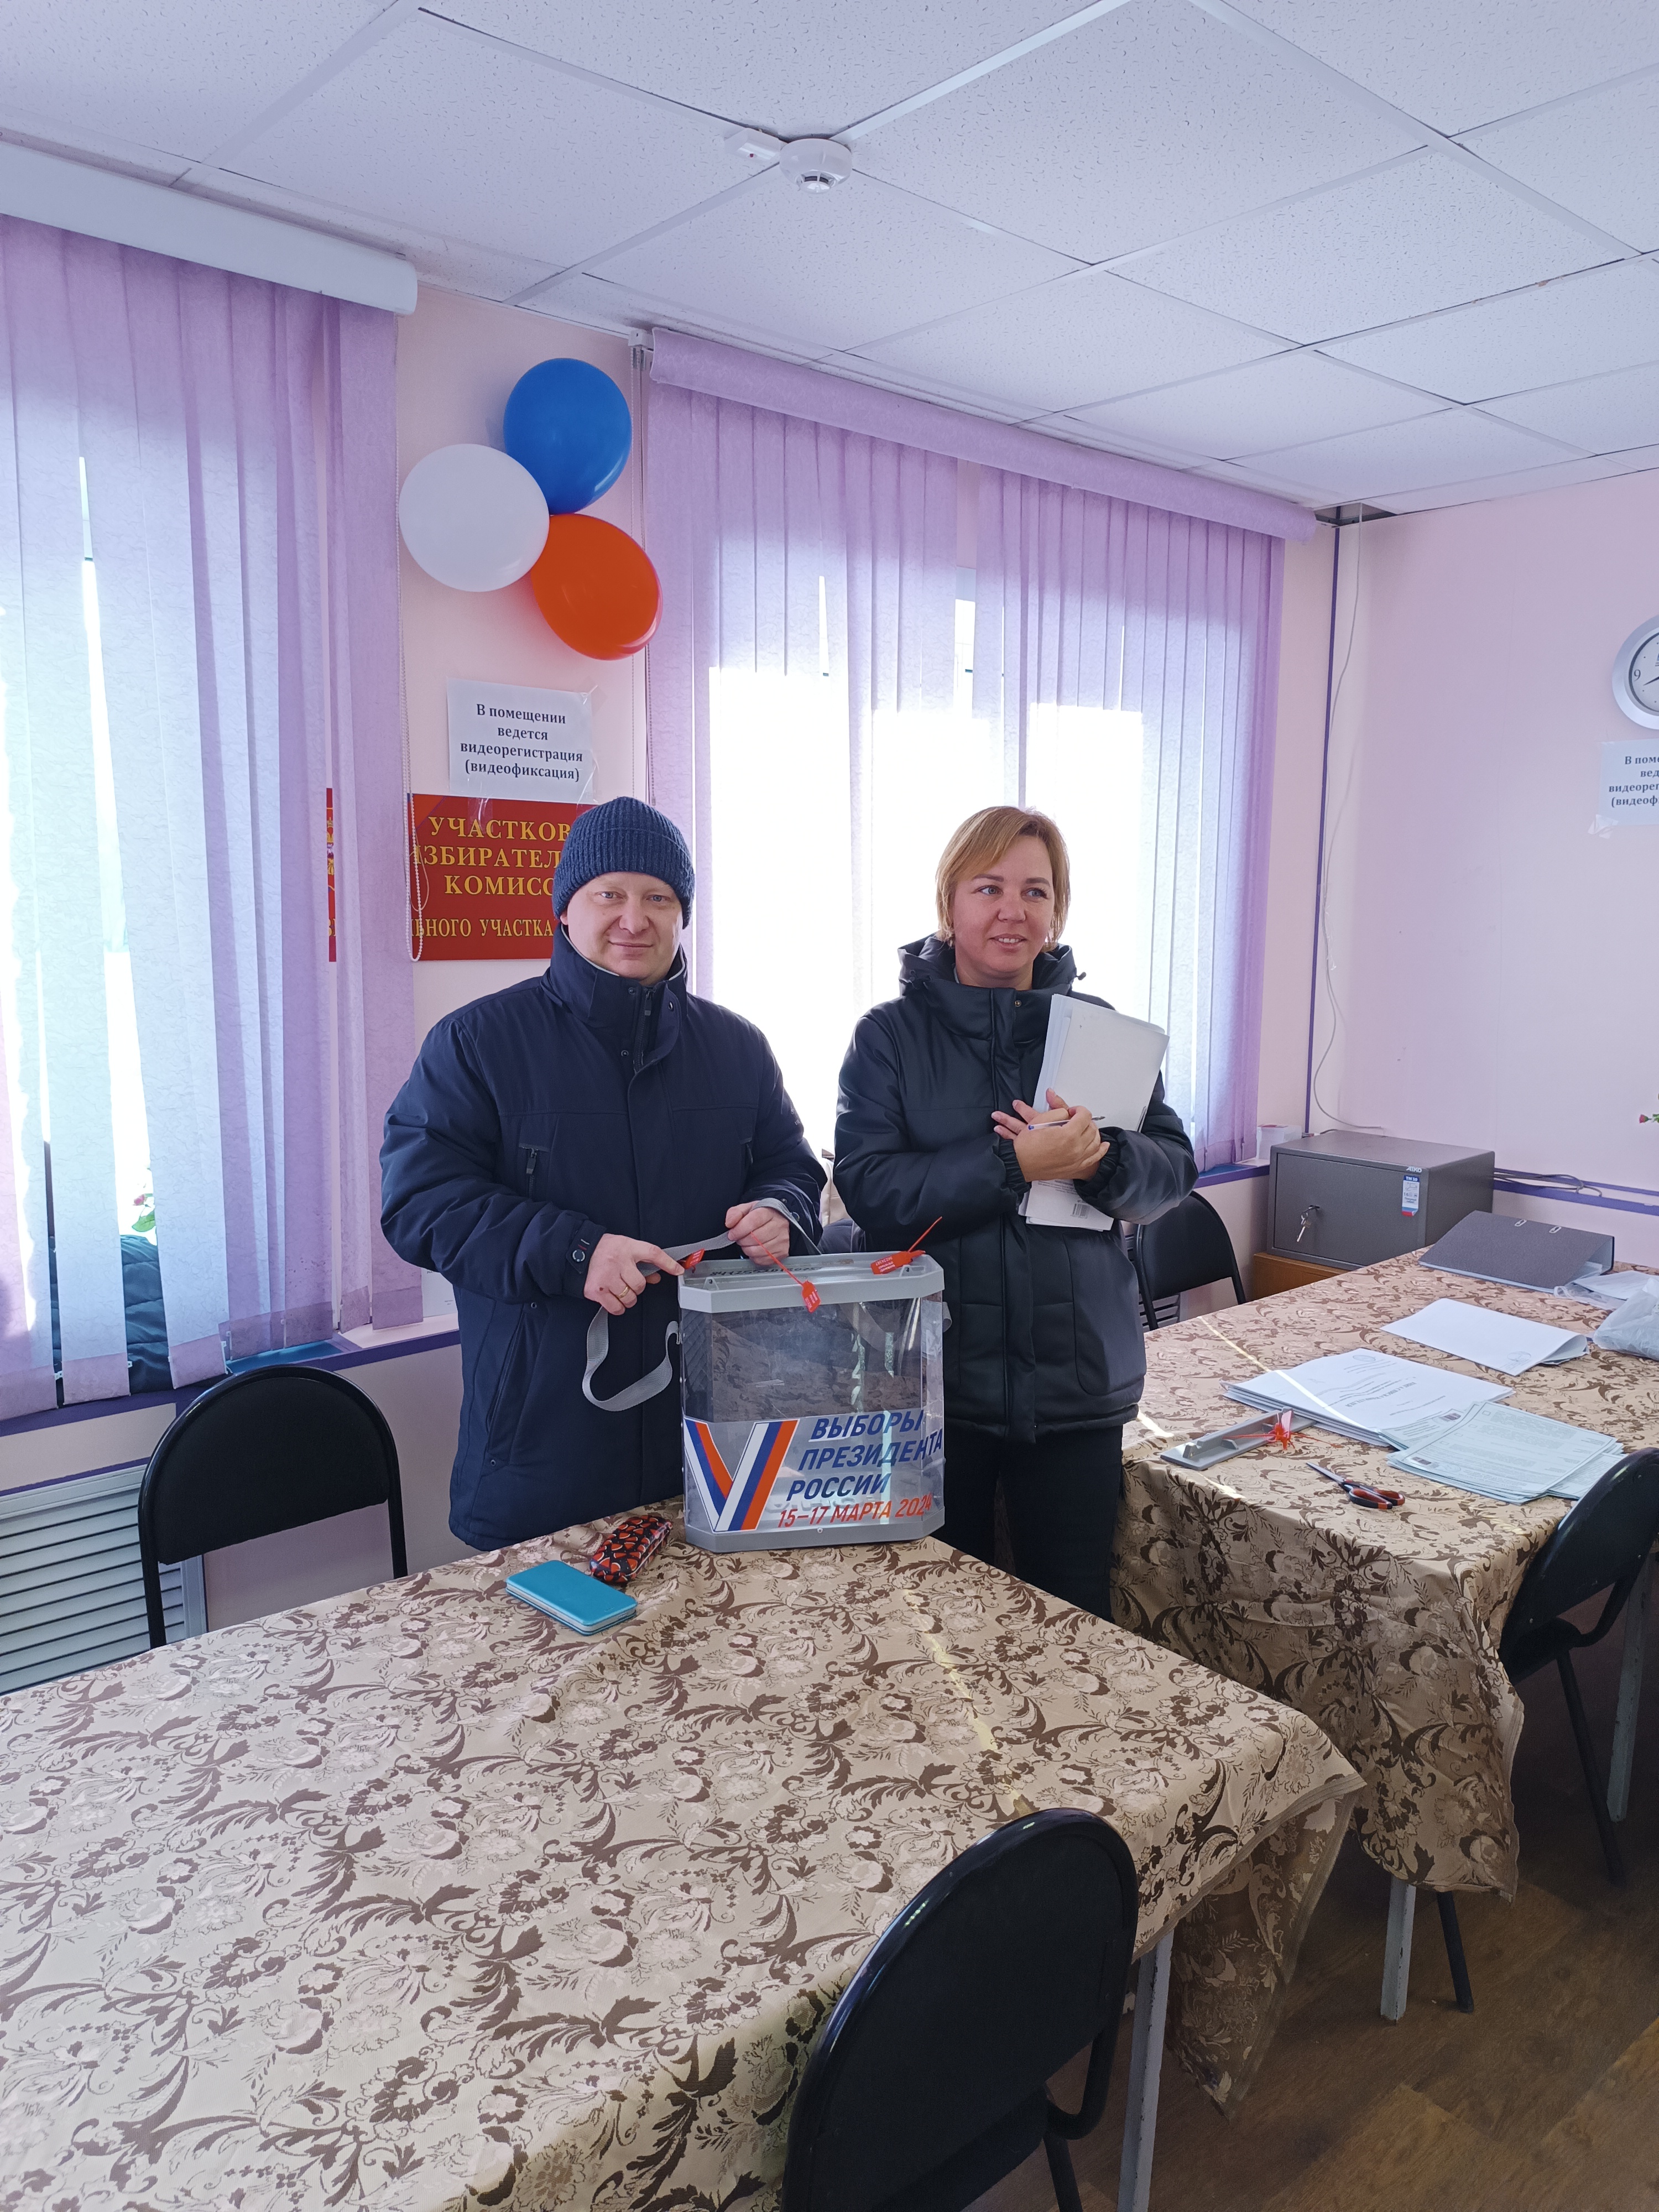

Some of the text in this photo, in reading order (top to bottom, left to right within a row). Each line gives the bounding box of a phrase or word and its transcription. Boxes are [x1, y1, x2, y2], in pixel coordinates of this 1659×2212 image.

[1634, 669, 1641, 681] 9
[476, 703, 566, 724] В помещении
[498, 727, 548, 740] ведется
[461, 743, 583, 762] видеорегистрация
[1625, 756, 1631, 765] В
[465, 759, 580, 782] (видеофиксация)
[1611, 795, 1659, 808] (видеоф
[428, 817, 571, 841] УЧАСТКОВ
[411, 919, 554, 937] ЬНОГО УЧАСТКА
[811, 1410, 924, 1440] ВЫБОРЫ
[798, 1428, 942, 1470] ПРЕЗИДЕНТА
[786, 1473, 891, 1501] РОССИИ
[830, 1500, 892, 1524] МАРТА
[895, 1492, 932, 1517] 2024
